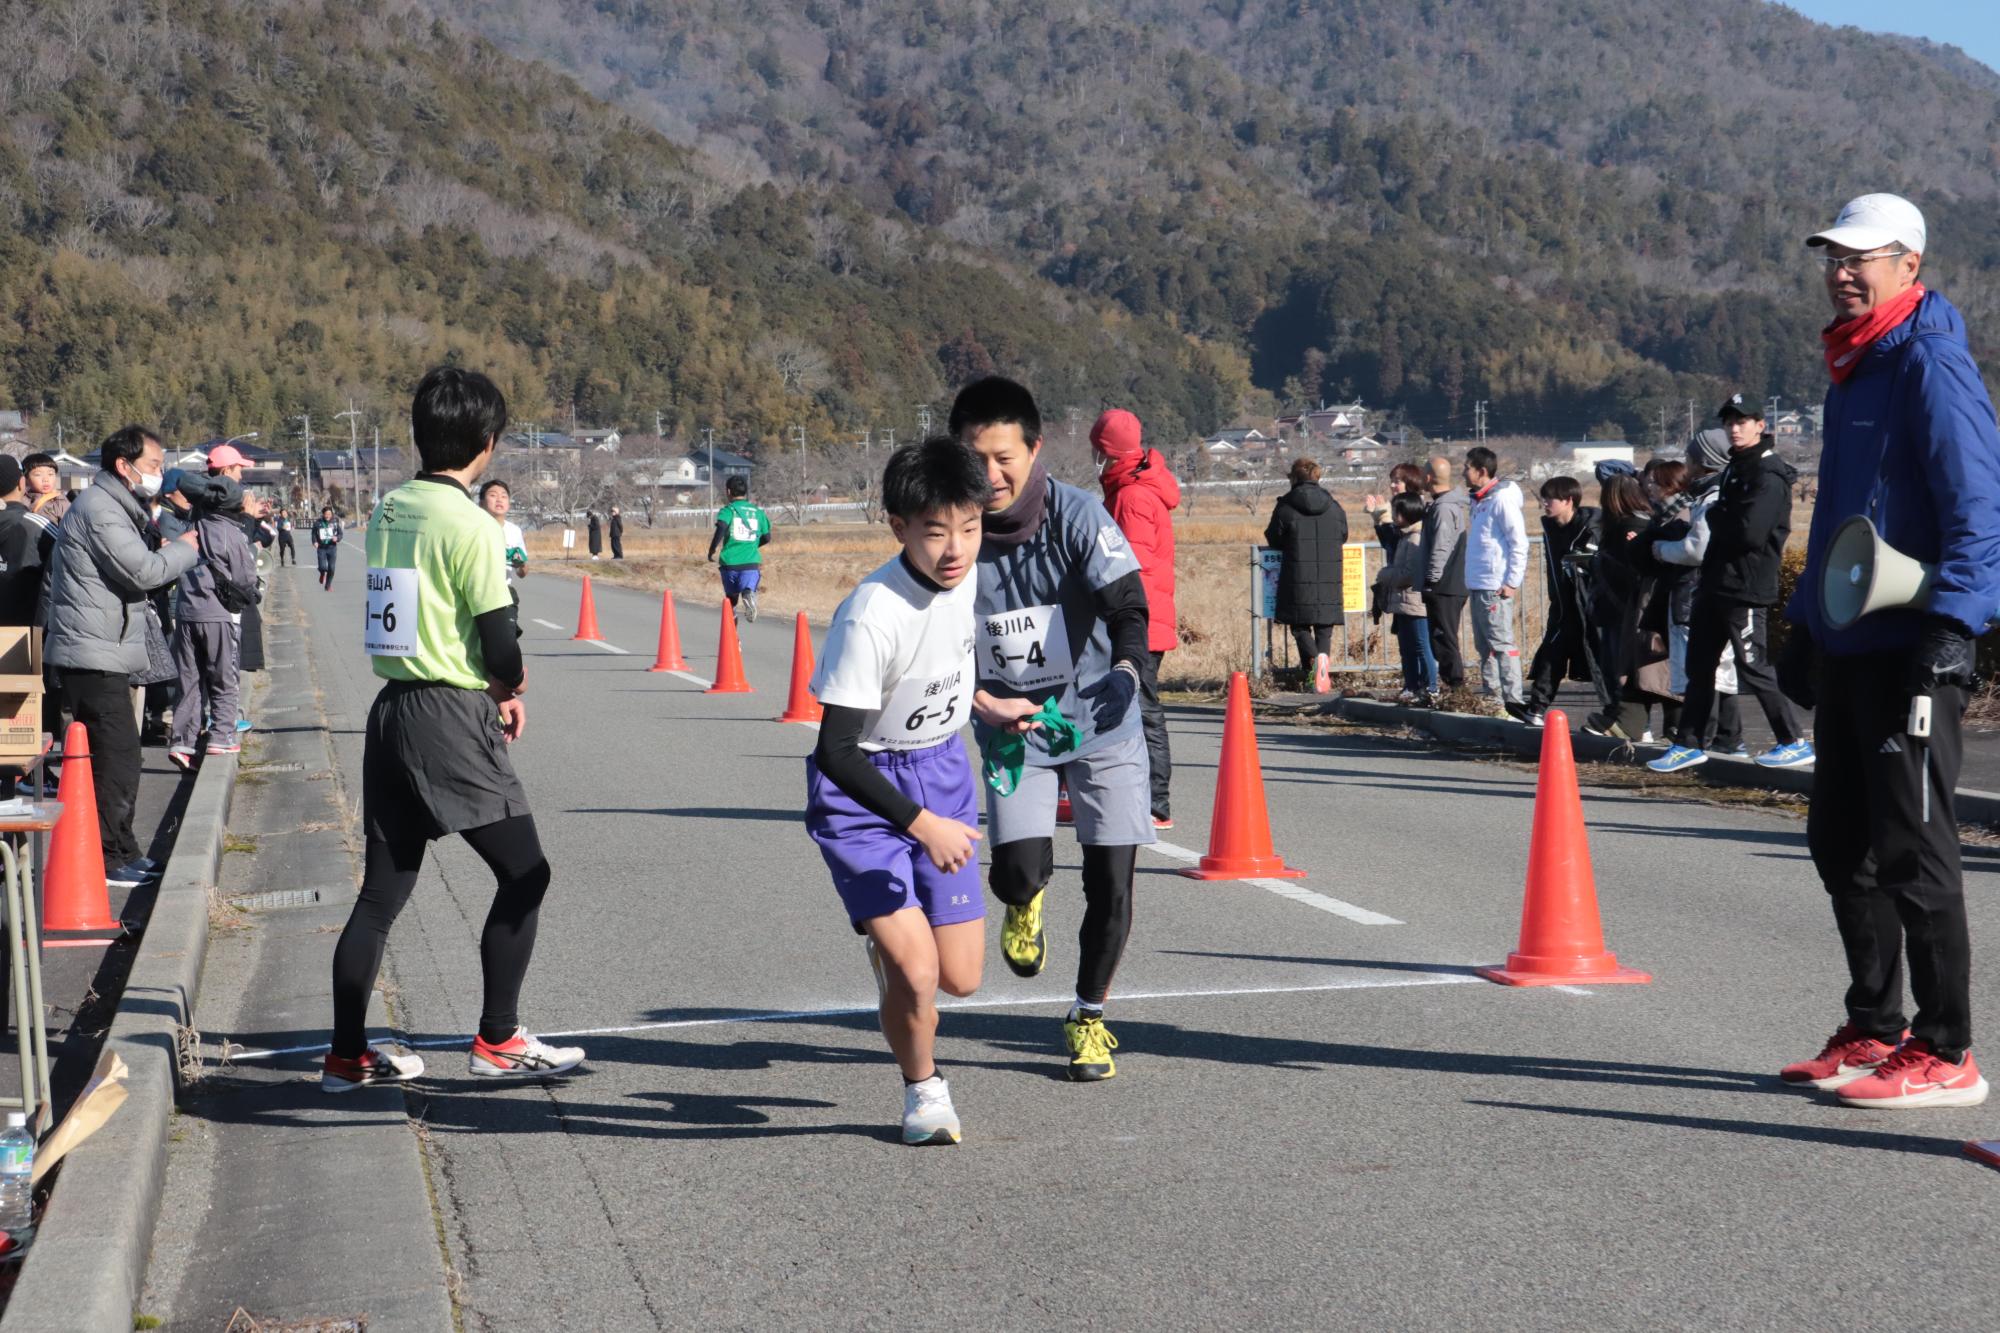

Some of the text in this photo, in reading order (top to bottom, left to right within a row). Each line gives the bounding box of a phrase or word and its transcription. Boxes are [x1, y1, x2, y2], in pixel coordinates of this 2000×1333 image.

[985, 616, 1035, 636] 後川A
[991, 641, 1046, 668] 6-4
[924, 670, 960, 697] 後川A
[905, 695, 959, 731] 6-5
